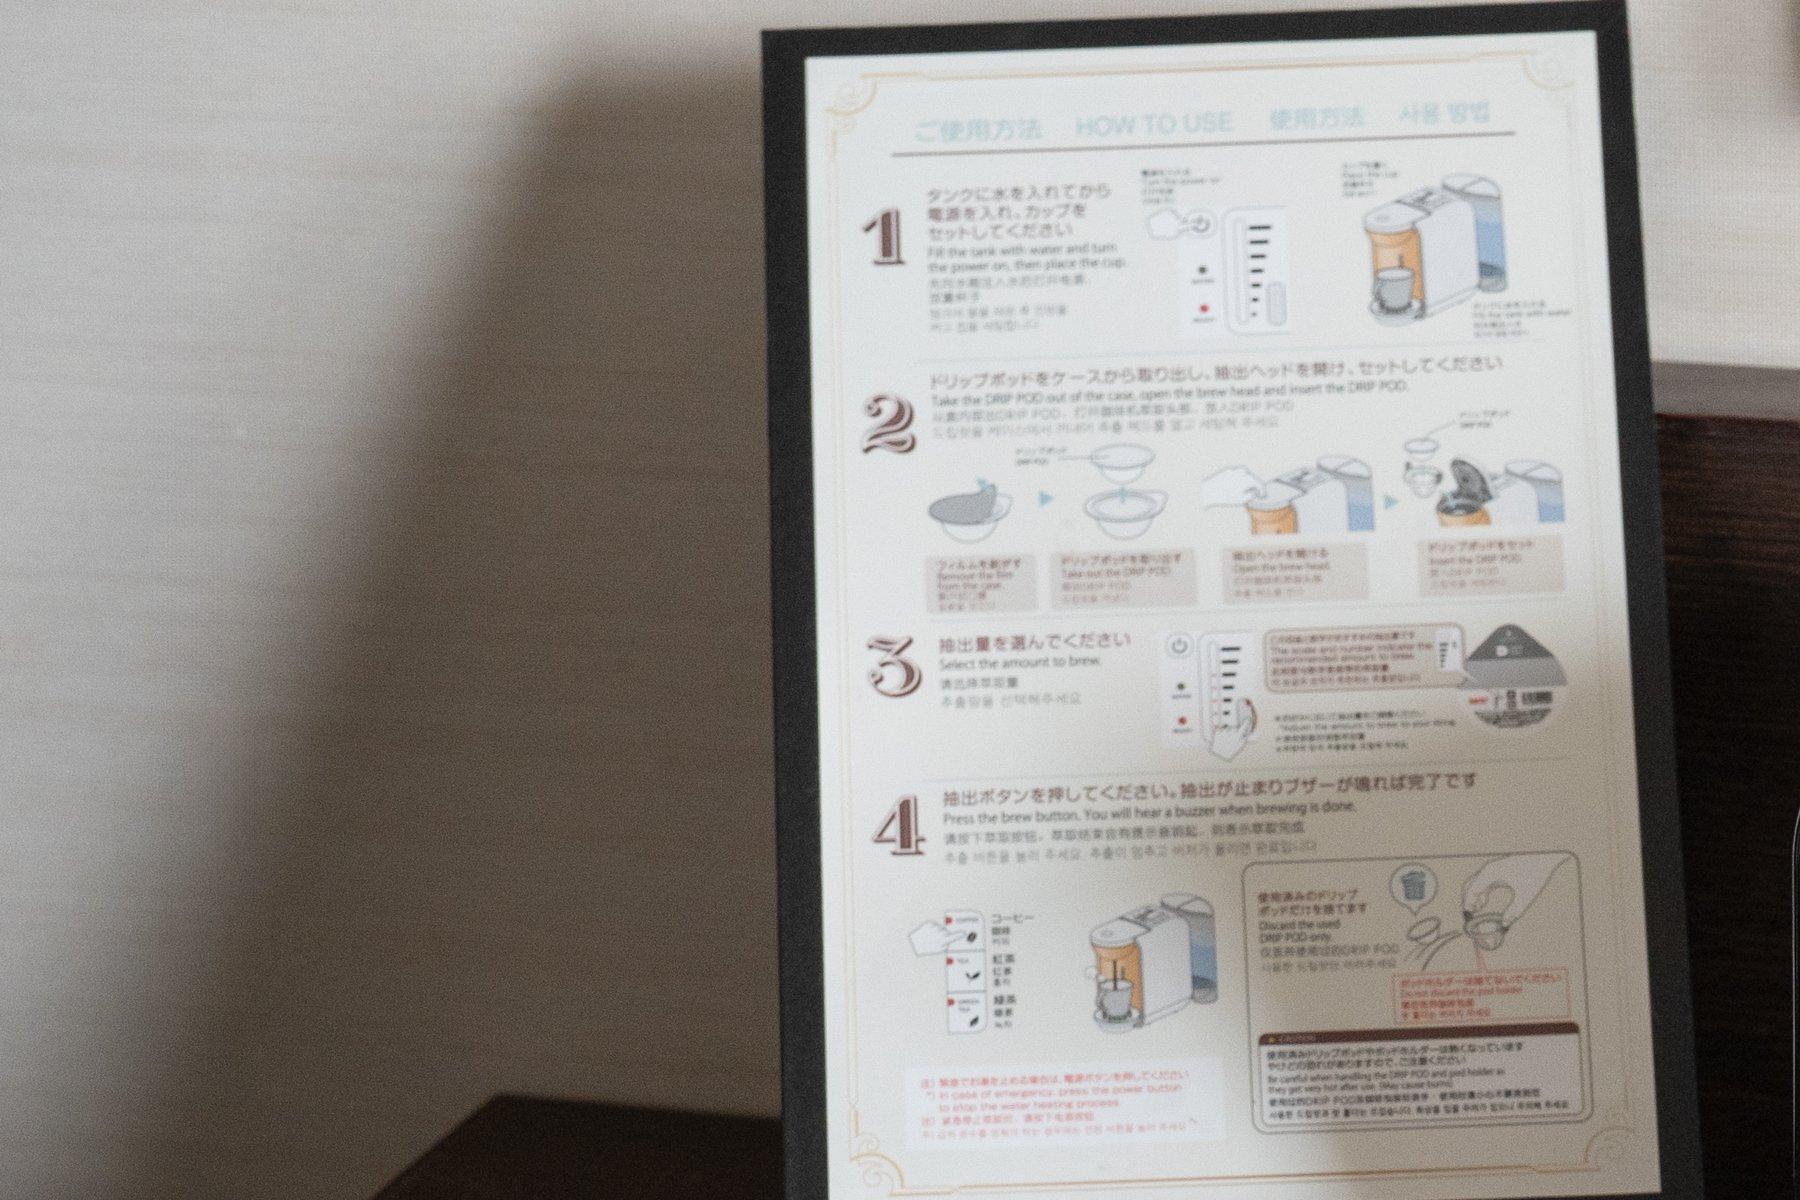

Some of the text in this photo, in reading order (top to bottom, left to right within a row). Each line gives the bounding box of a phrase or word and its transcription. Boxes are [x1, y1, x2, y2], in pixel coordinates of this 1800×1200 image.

[1076, 112, 1233, 137] HOW TO USE
[1270, 106, 1365, 130] 使用方法
[916, 117, 1042, 143] ご使用方法
[928, 183, 1110, 203] タンクに水を入れてから
[863, 208, 905, 265] 1
[928, 223, 1073, 242] セットしてください
[949, 247, 966, 257] the
[971, 247, 995, 257] tank
[1001, 245, 1024, 255] with
[1031, 245, 1062, 254] water
[1067, 243, 1089, 254] and
[929, 262, 947, 272] the
[952, 262, 989, 273] power
[1014, 260, 1040, 270] then
[1080, 258, 1098, 267] the
[964, 395, 980, 404] the
[1047, 393, 1066, 402] out
[1070, 391, 1082, 402] of
[1088, 390, 1105, 401] the
[1174, 387, 1192, 398] the
[1197, 387, 1226, 398] brew
[1231, 386, 1261, 396] head
[1265, 384, 1286, 395] and
[1326, 382, 1344, 392] the
[862, 393, 916, 453] 2
[867, 636, 922, 698] 3
[940, 658, 975, 670] Select
[979, 658, 998, 669] the
[1002, 657, 1049, 669] amount
[1053, 656, 1066, 666] to
[873, 794, 926, 856] 4
[944, 813, 974, 825] Press
[977, 813, 997, 824] the
[1001, 812, 1032, 823] brew
[1085, 810, 1107, 821] You
[1112, 807, 1132, 819] will
[1134, 807, 1161, 819] hear
[1175, 807, 1215, 817] buzzer
[1219, 805, 1252, 816] when
[1256, 803, 1307, 816] brewing
[1309, 803, 1319, 812] is
[1298, 920, 1314, 928] the
